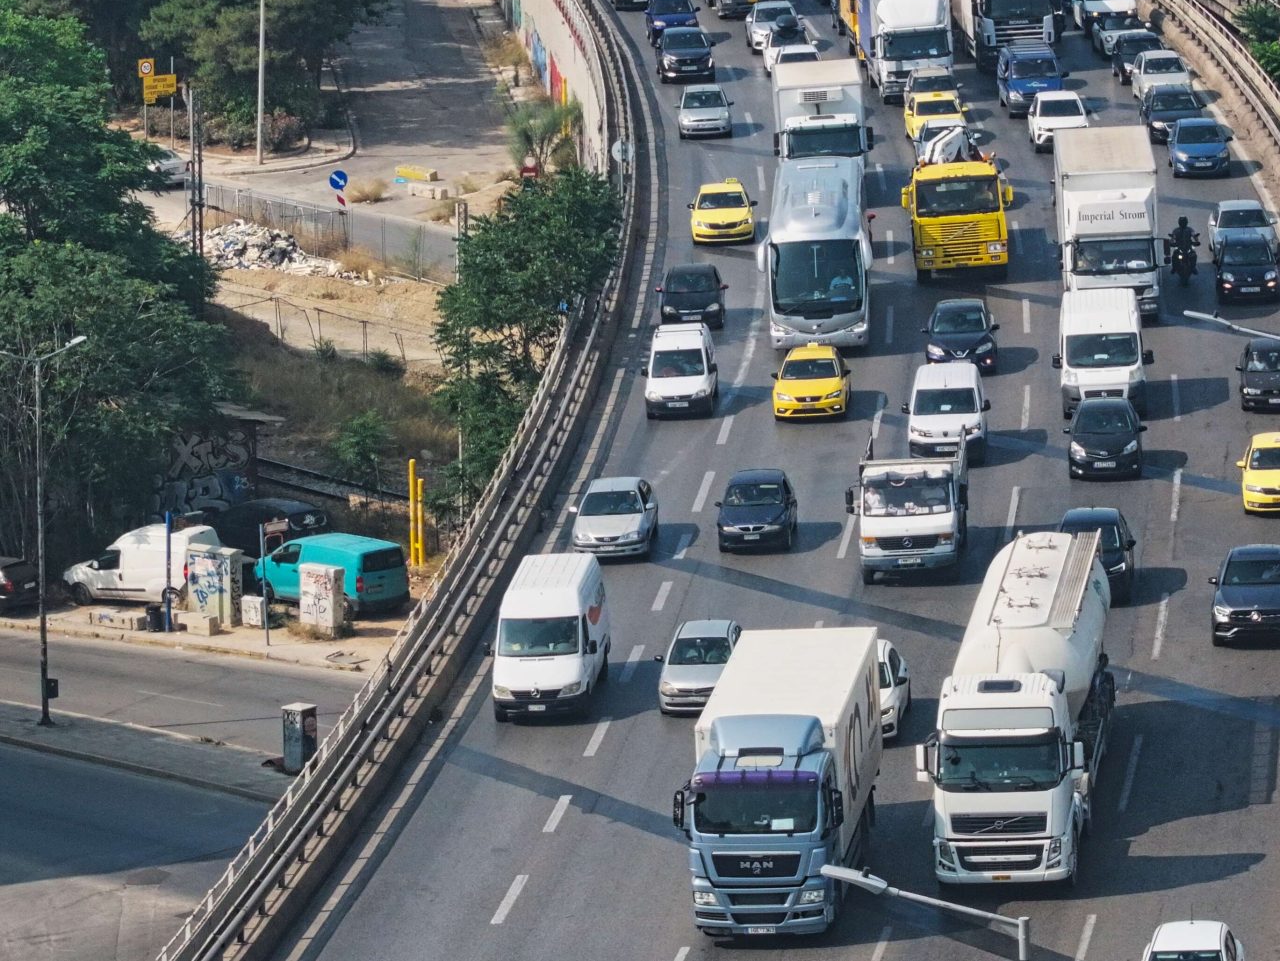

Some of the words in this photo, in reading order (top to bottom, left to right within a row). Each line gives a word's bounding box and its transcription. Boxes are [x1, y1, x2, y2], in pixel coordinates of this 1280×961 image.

[1078, 210, 1115, 223] Imperial
[1119, 210, 1146, 220] Strom
[740, 861, 774, 869] MAN
